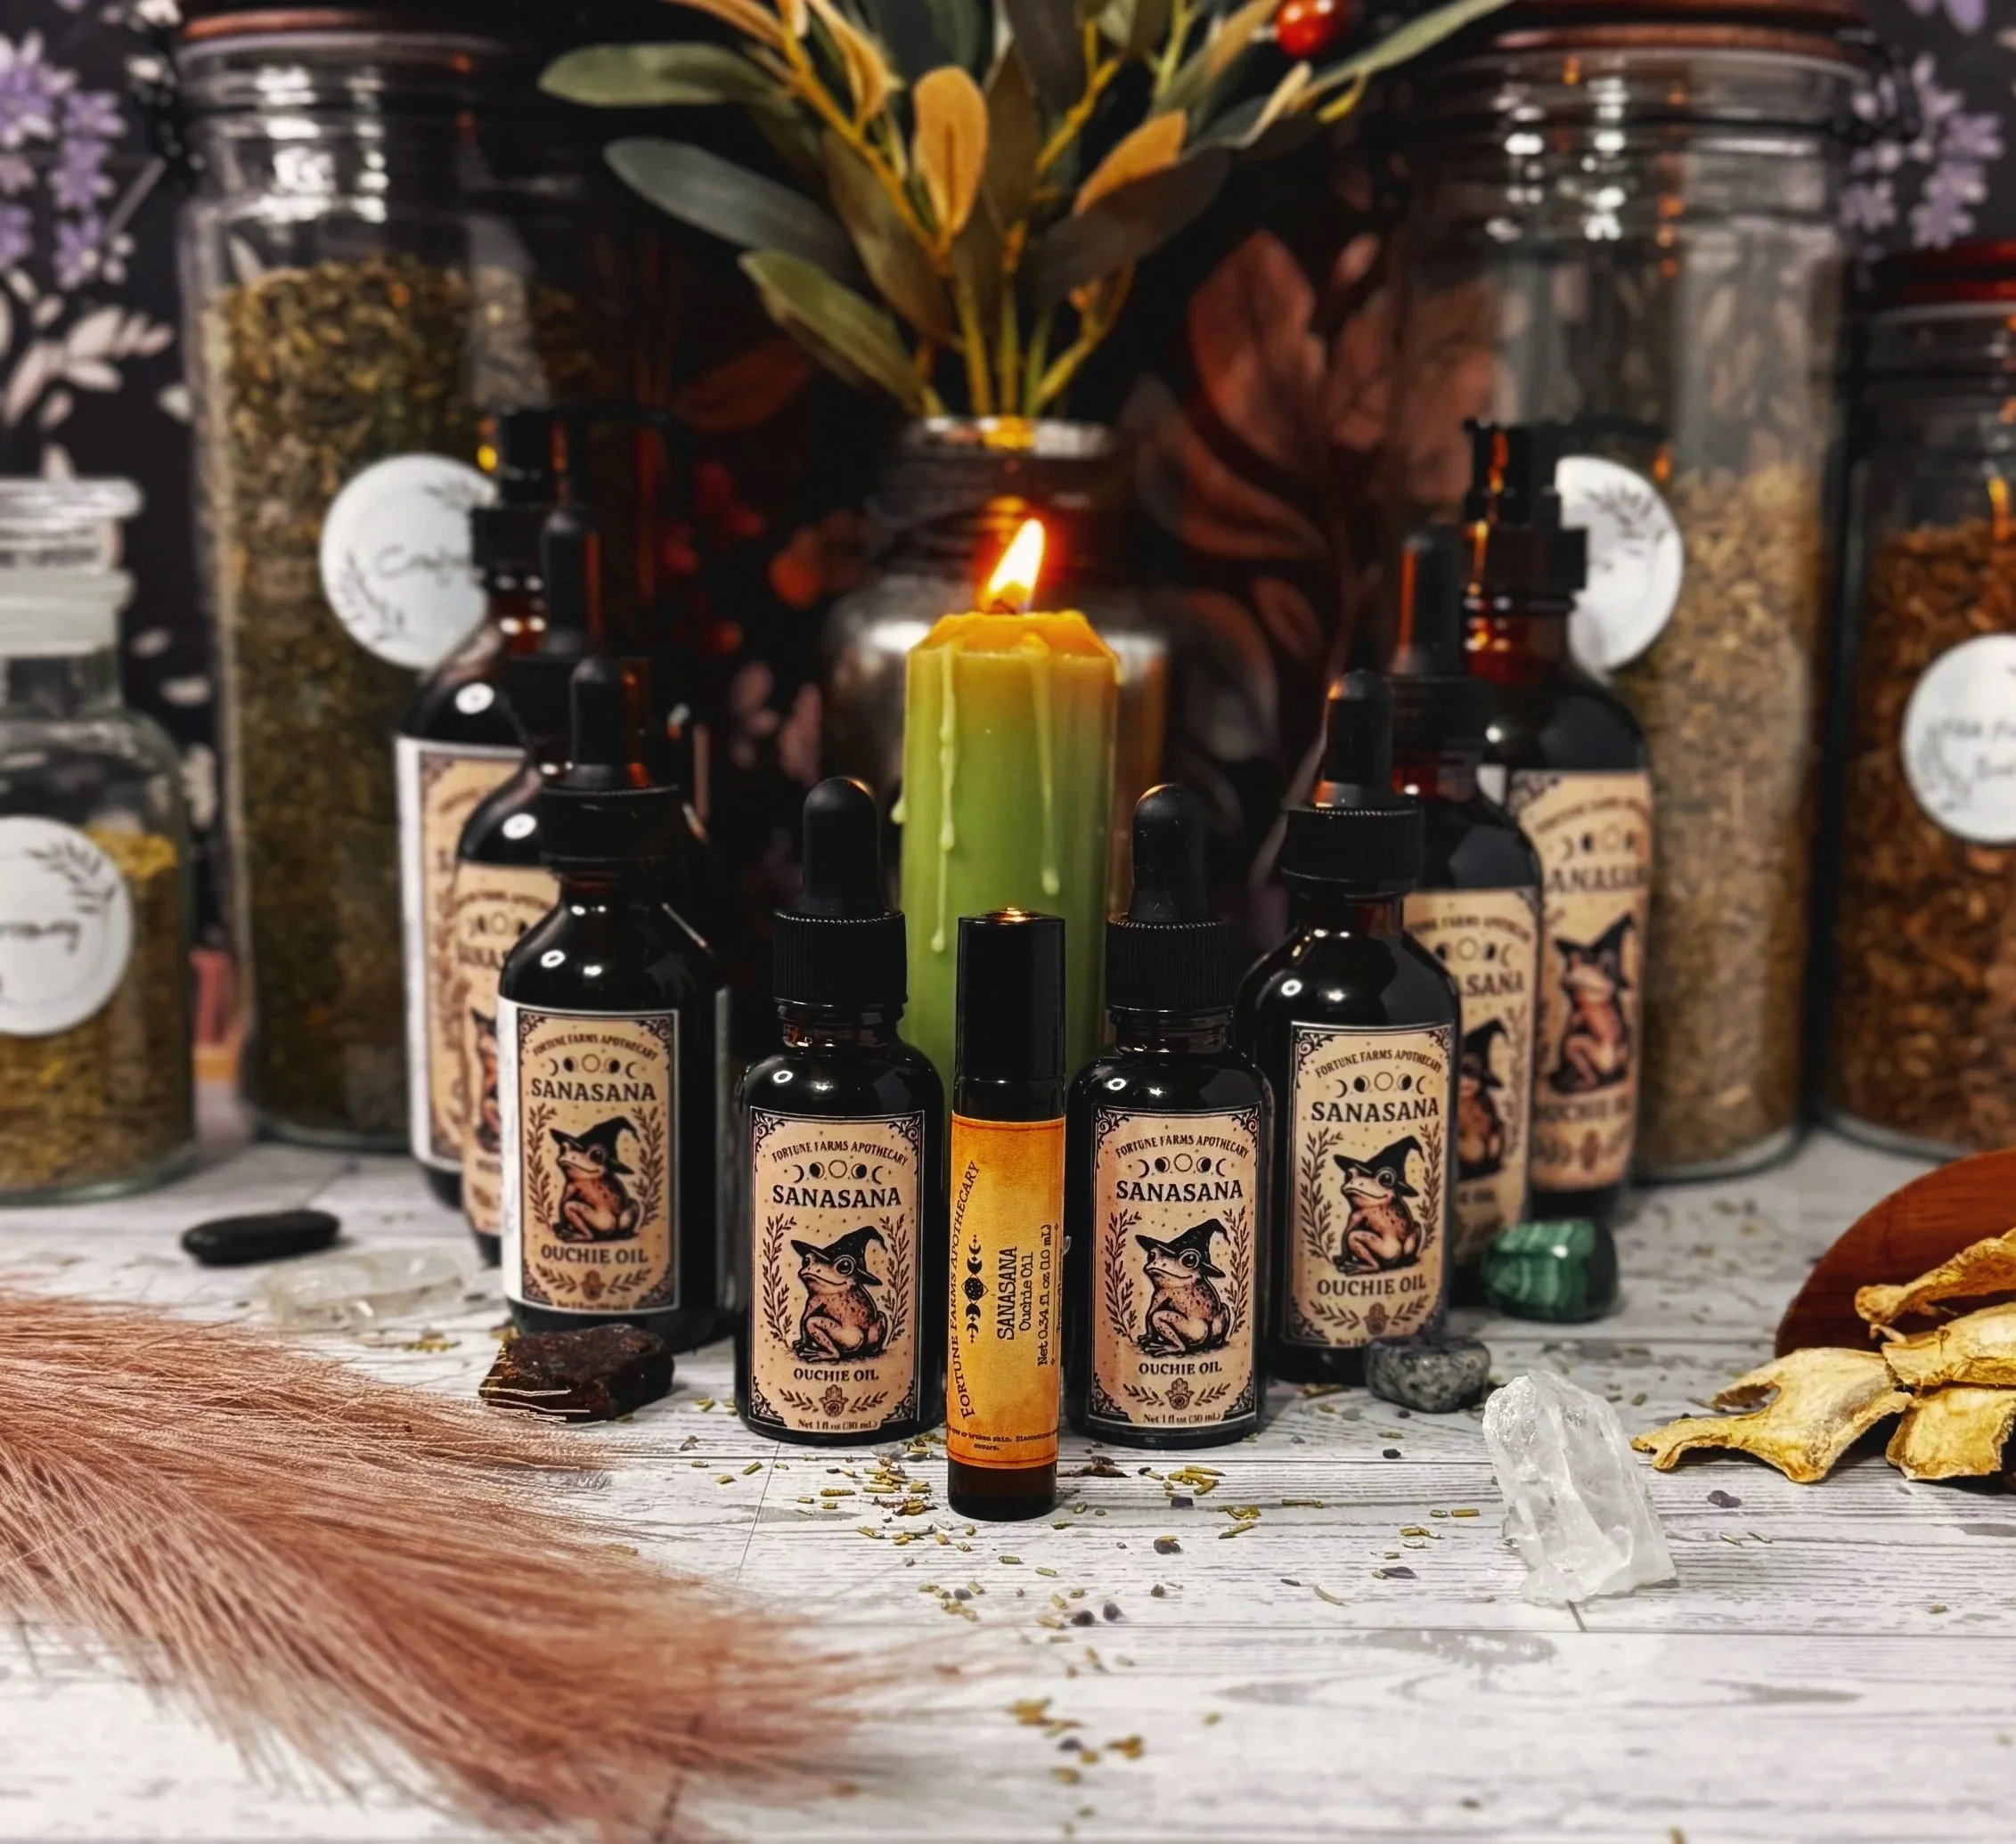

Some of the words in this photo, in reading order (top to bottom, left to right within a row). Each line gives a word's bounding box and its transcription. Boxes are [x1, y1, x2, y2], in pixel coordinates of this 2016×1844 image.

[534, 1035, 567, 1057] FORTUNE
[567, 1033, 599, 1044] FARMS
[600, 1035, 659, 1061] APOTHECARY
[1315, 1054, 1359, 1079] FORTUNE
[1360, 1049, 1393, 1062] FARMS
[1394, 1049, 1442, 1073] APOTHECARY
[531, 1077, 657, 1103] SANASANA
[1311, 1097, 1440, 1123] SANASANA
[771, 1141, 812, 1163] FORTUNE
[814, 1140, 849, 1152] FARMS
[851, 1140, 910, 1166] APOTHECARY
[1115, 1137, 1157, 1159] FORTUNE
[1160, 1135, 1195, 1146] FARMS
[1196, 1135, 1249, 1159] APOTHECARY
[772, 1184, 902, 1209] SANASANA
[1116, 1179, 1244, 1203] SANASANA
[951, 1160, 980, 1269] APOTHECARY
[1041, 1225, 1051, 1246] mL)
[541, 1244, 610, 1263] OUCHIE
[616, 1248, 649, 1264] OIL
[1021, 1252, 1033, 1277] Oil
[1040, 1250, 1050, 1269] (10
[1042, 1272, 1050, 1289] oz
[1317, 1278, 1395, 1297] OUCHIE
[1400, 1274, 1427, 1291] OIL
[997, 1246, 1017, 1341] SANASANA
[1019, 1280, 1032, 1331] Ouchie
[1040, 1291, 1050, 1306] fl
[1038, 1308, 1049, 1340] 0.34
[1038, 1342, 1049, 1367] Net
[793, 1367, 850, 1382] OUCHIE
[853, 1368, 879, 1382] OIL
[951, 1335, 975, 1419] FORTUNE
[1139, 1362, 1196, 1375] OUCHIE
[1199, 1361, 1223, 1374] OIL
[798, 1418, 813, 1429] Net
[1144, 1414, 1158, 1423] Net
[1163, 1415, 1166, 1424] 1
[968, 1432, 992, 1441] broken
